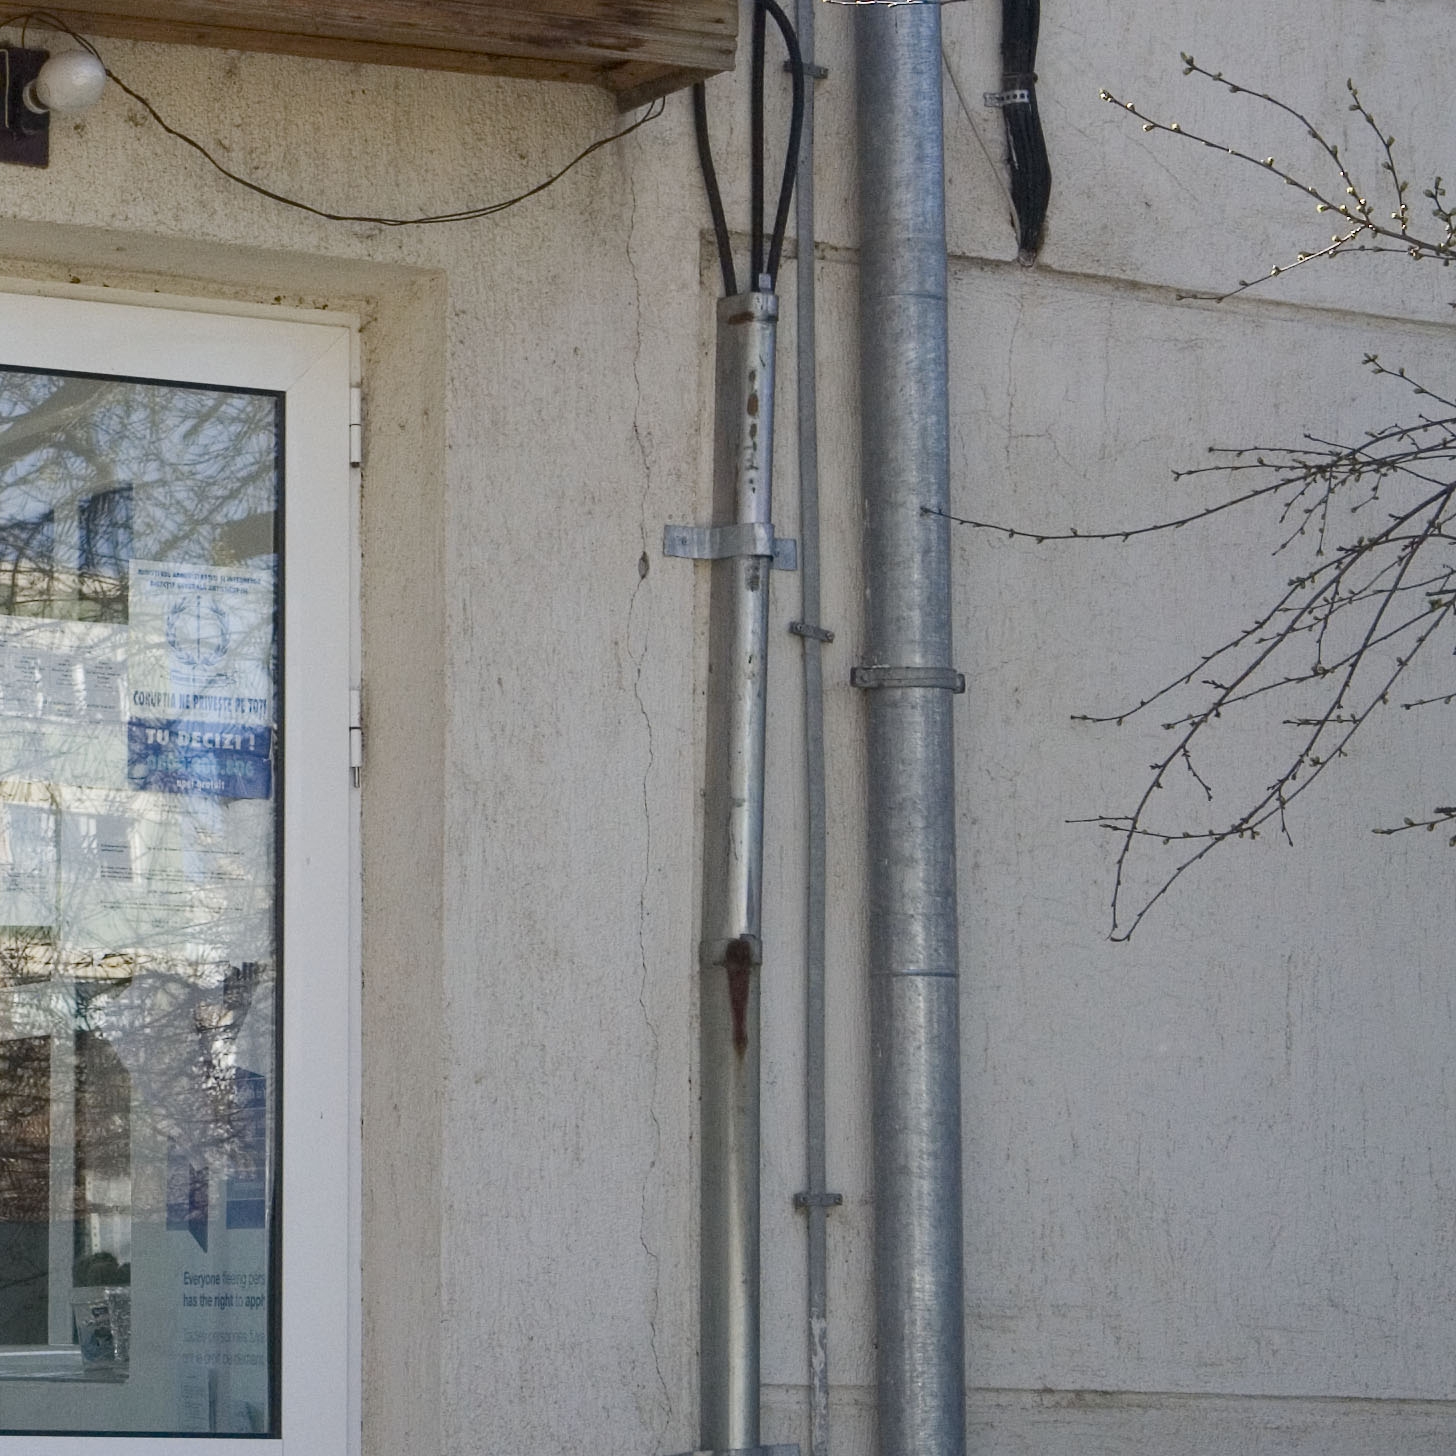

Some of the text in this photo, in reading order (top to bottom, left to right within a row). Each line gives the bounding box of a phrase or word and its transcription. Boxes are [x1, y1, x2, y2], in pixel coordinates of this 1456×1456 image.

[145, 728, 170, 745] TU
[177, 731, 242, 750] DECIZI
[184, 1271, 221, 1288] Everyone
[184, 1293, 197, 1307] has
[199, 1293, 213, 1307] the
[214, 1292, 234, 1310] right
